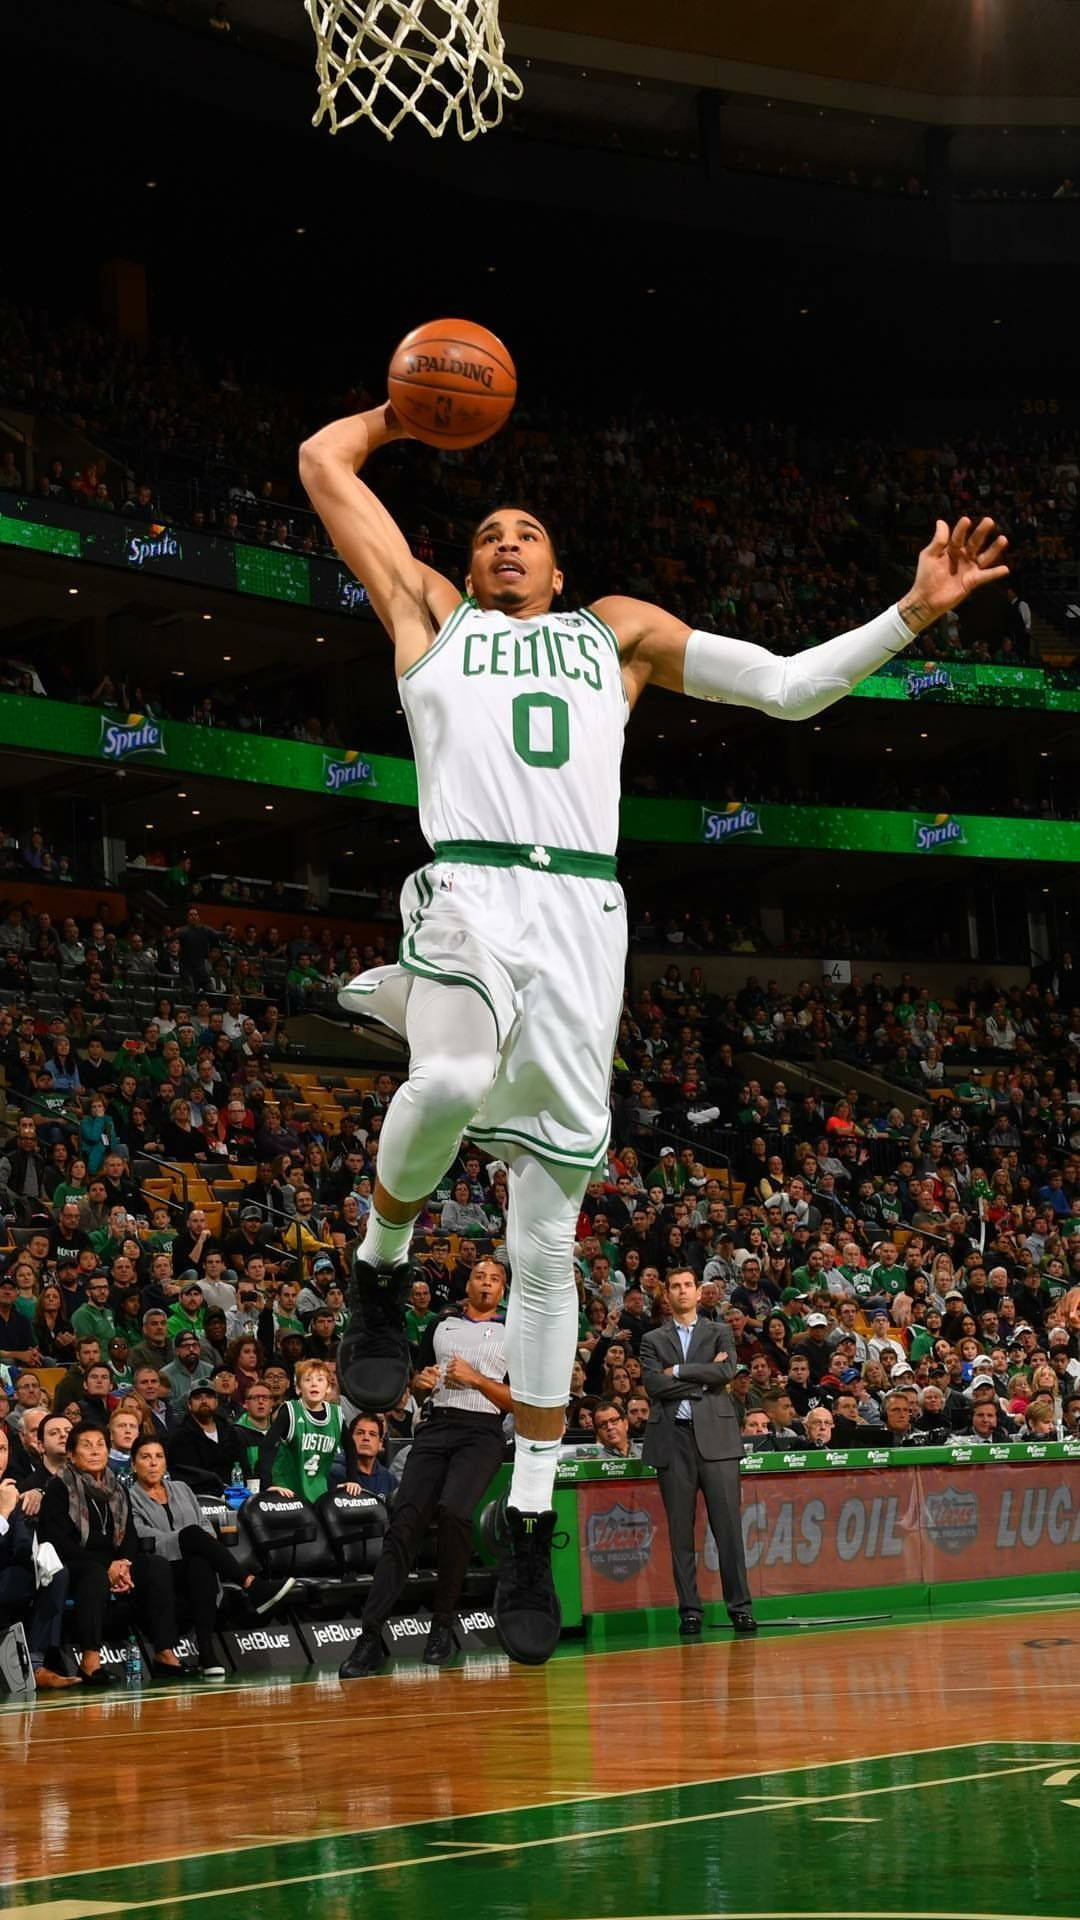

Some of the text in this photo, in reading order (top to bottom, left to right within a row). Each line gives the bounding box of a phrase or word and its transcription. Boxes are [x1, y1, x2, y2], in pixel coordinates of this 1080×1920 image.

[406, 355, 494, 389] SPALDING
[128, 534, 177, 564] Sprite
[340, 583, 367, 608] Spr
[463, 626, 602, 690] CELTICS
[104, 721, 158, 756] Sprite
[512, 692, 570, 769] 0
[326, 761, 370, 789] Sprite
[705, 807, 755, 840] Sprite
[916, 823, 960, 848] Sprite
[832, 963, 842, 980] 4
[303, 1454, 320, 1476] 4
[267, 1500, 304, 1512] Putnam
[342, 1497, 378, 1508] Putnam
[837, 1497, 903, 1562] OIL
[386, 1618, 432, 1641] jetBlu
[457, 1611, 496, 1635] jetBlu
[234, 1631, 290, 1655] jetBlue
[311, 1624, 363, 1648] jetBlue
